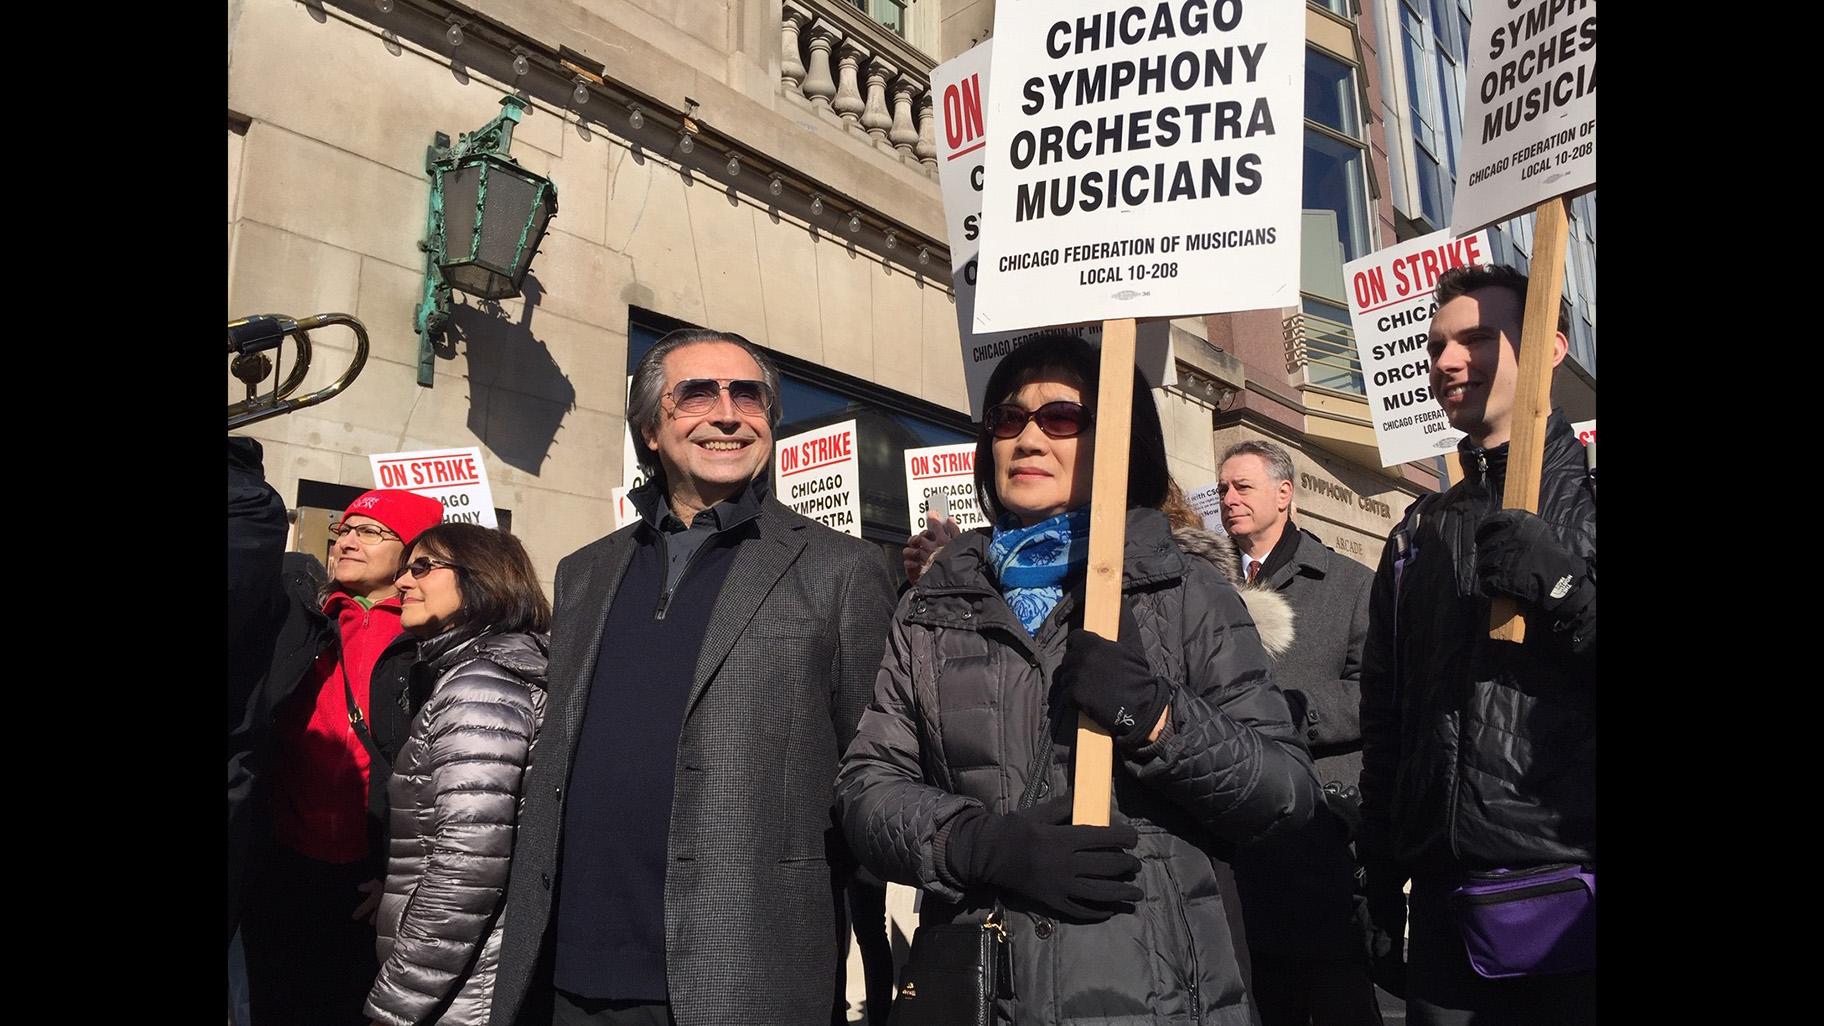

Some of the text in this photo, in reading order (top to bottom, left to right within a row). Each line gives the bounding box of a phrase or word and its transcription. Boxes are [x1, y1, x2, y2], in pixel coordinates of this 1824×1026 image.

[1046, 0, 1243, 59] CHICAGO
[1021, 43, 1267, 115] SYMPHONY
[943, 73, 984, 149] ON
[1009, 97, 1276, 169] ORCHESTRA
[1469, 157, 1509, 187] CHICAGO
[1512, 127, 1576, 166] FEDERATION
[1580, 120, 1595, 137] OF
[1522, 161, 1552, 181] LOCAL
[1555, 142, 1593, 166] 10-208
[1015, 153, 1263, 222] MUSICIANS
[999, 227, 1277, 272] CHICAGO FEDERATION OF MUSICIANS
[1080, 262, 1178, 286] LOCAL 10-208
[1354, 266, 1387, 308] ON
[1383, 417, 1413, 431] CHICAGO
[1424, 421, 1446, 434] LOCAL
[781, 431, 851, 472] ON STRIKE
[911, 456, 929, 476] ON
[379, 458, 479, 488] ON STRIKE
[791, 474, 842, 499] CHICAGO
[788, 491, 849, 514] YMPHONY
[1300, 472, 1391, 519] SYMPHONY CENTER
[1335, 536, 1363, 555] ARCADE
